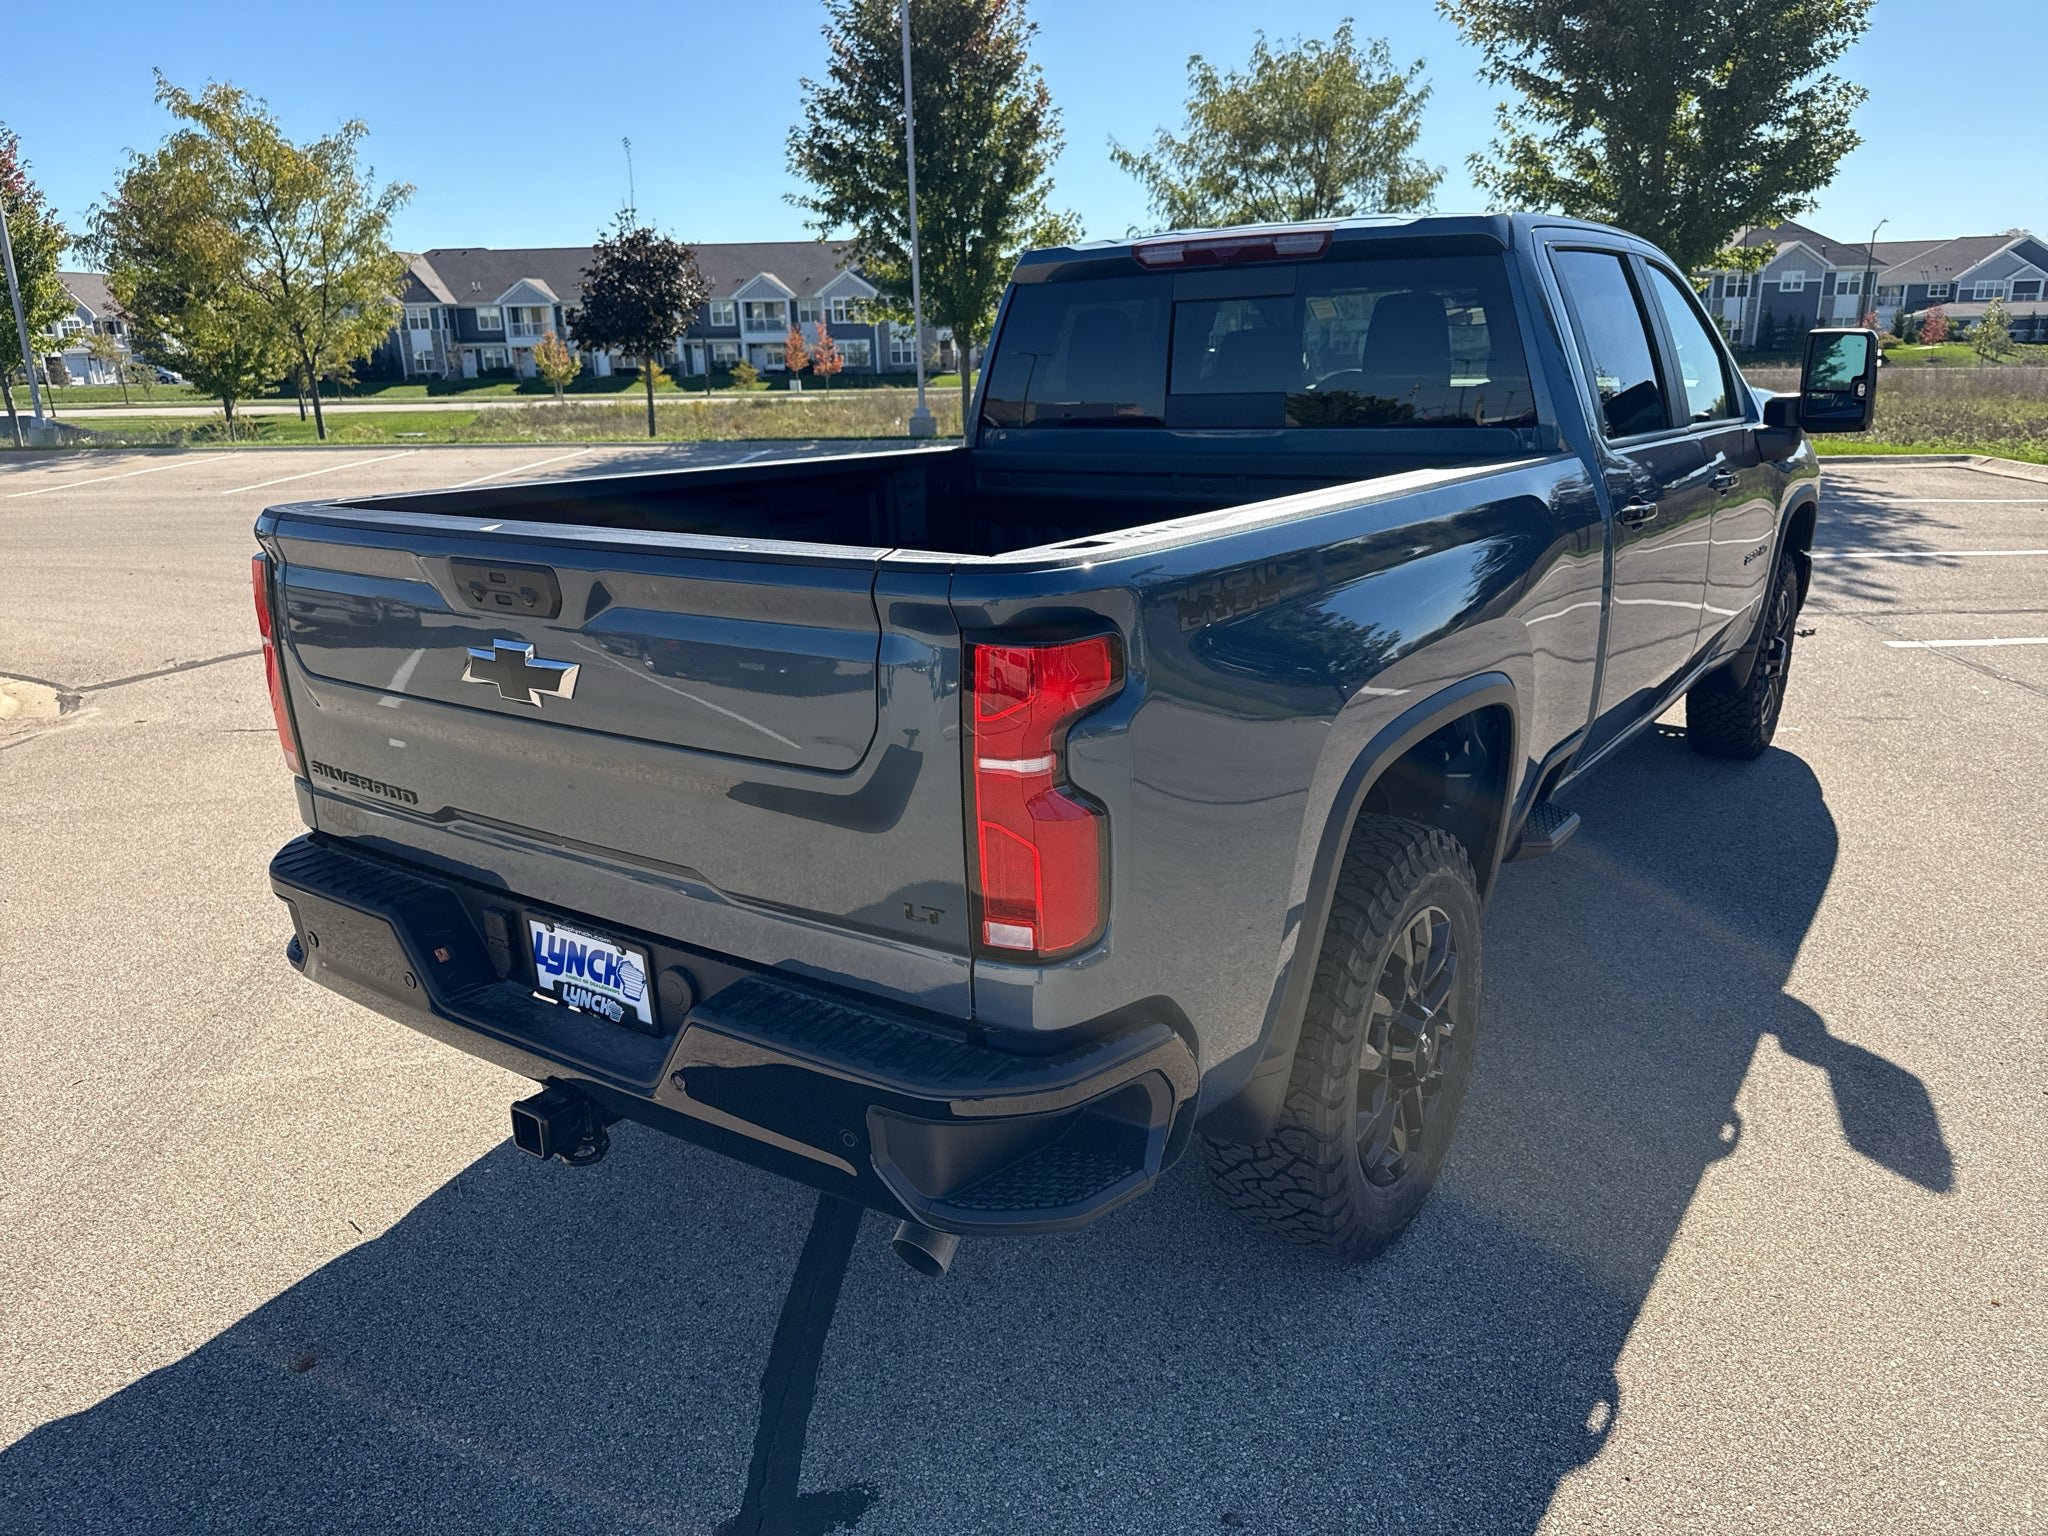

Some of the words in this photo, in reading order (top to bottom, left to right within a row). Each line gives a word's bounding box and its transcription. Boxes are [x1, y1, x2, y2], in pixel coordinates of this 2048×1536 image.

[310, 760, 419, 805] SILVERADO
[903, 902, 946, 925] LT
[553, 922, 612, 945] shoplynch.com
[534, 931, 624, 989] LYNCH
[562, 983, 612, 1016] LYNCH
